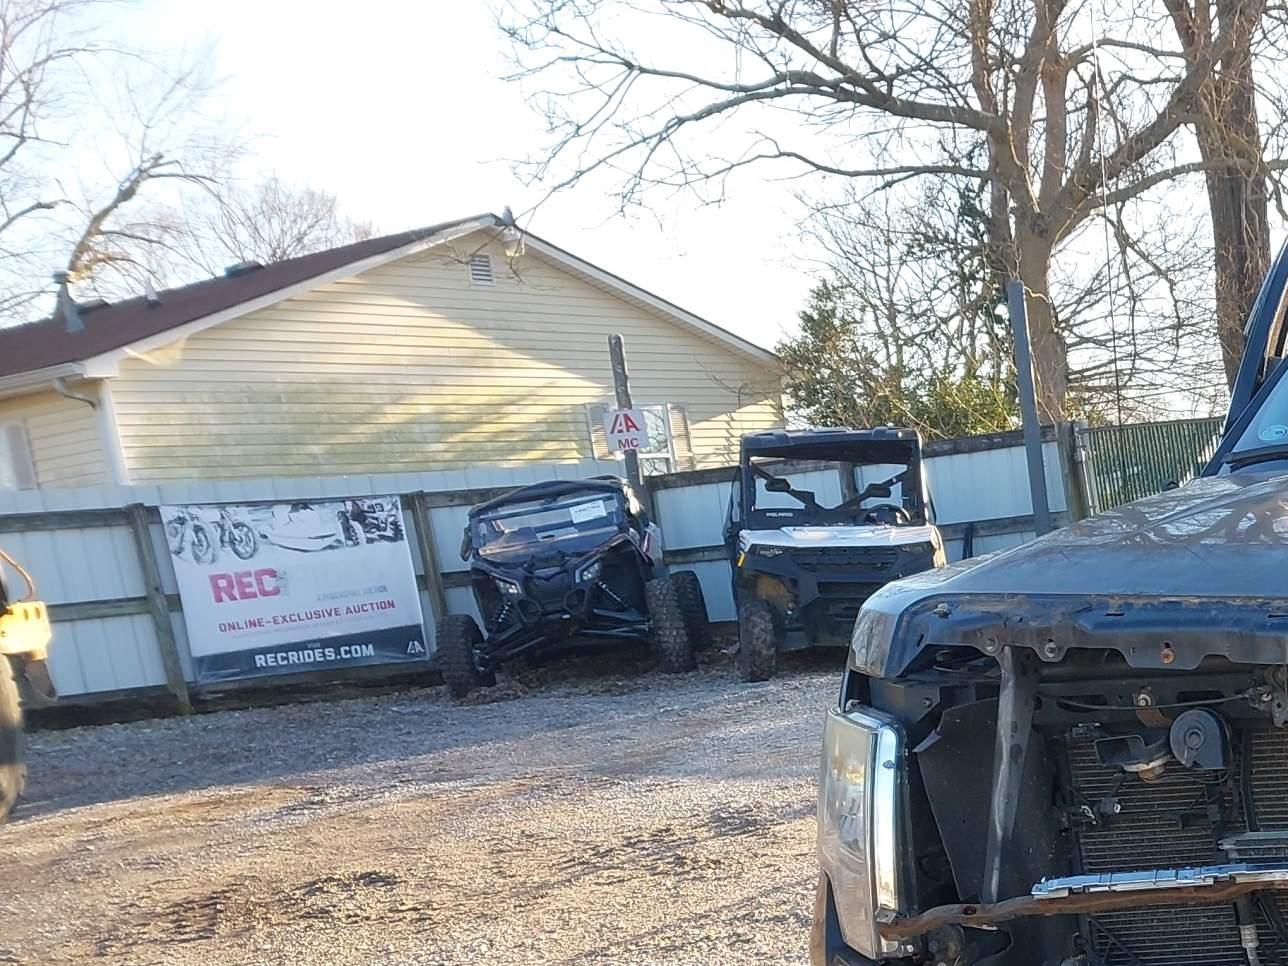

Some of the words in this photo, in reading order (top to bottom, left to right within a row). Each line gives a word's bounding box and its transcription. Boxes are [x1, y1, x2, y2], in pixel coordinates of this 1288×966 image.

[617, 437, 640, 449] MC
[208, 567, 281, 603] REC
[219, 607, 342, 632] ONLINE-EXCLUSIVE
[345, 599, 396, 614] AUCTION
[254, 643, 375, 668] RECRIDES.COM
